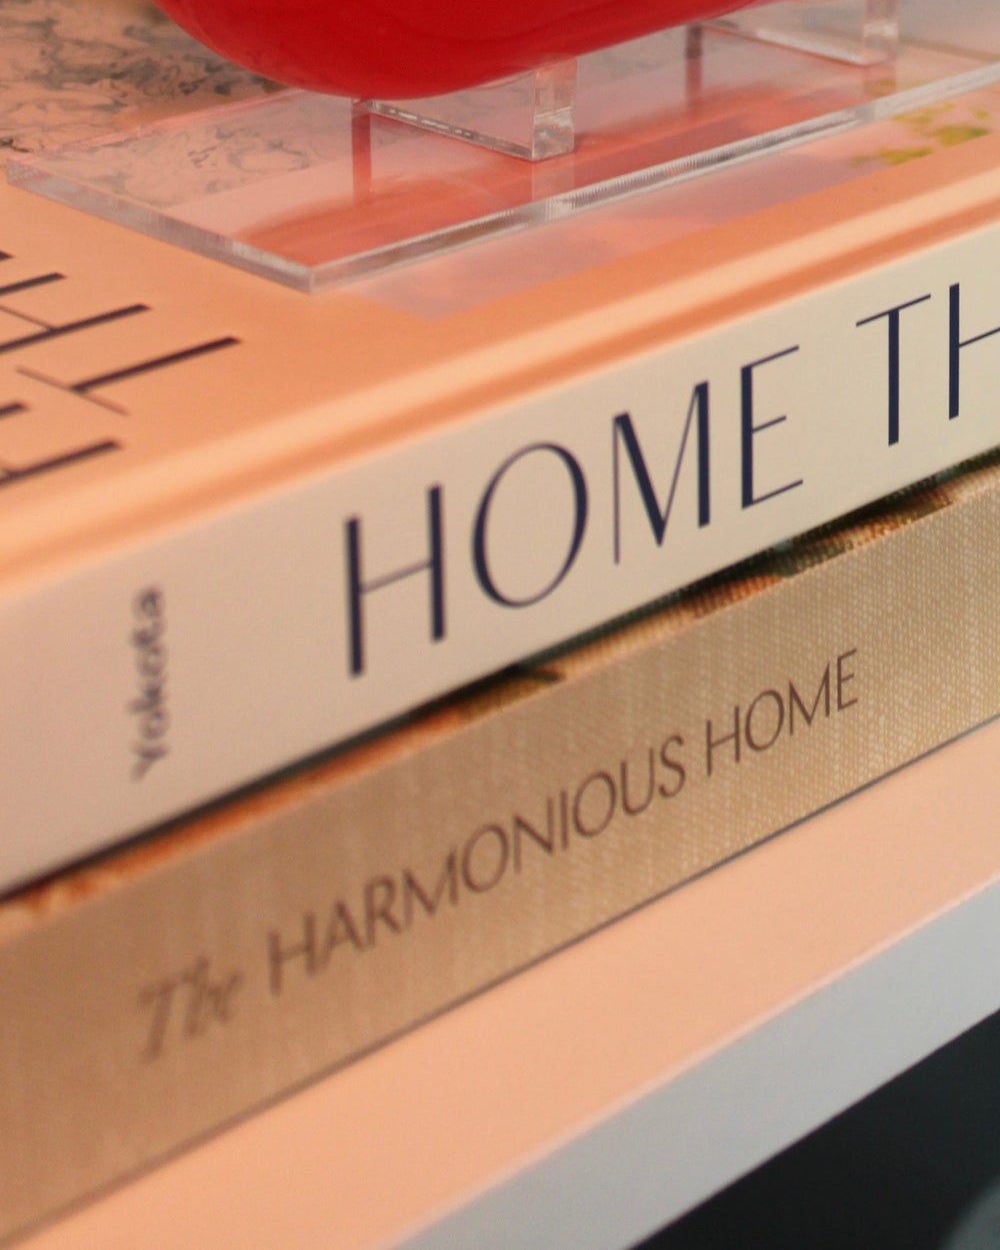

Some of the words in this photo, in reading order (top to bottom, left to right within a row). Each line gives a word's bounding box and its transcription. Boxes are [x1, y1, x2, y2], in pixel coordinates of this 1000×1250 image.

[344, 345, 803, 678] HOME
[129, 585, 171, 783] Yokota
[137, 953, 244, 1064] The
[267, 734, 687, 996] HARMONIOUS
[704, 648, 860, 777] HOME
